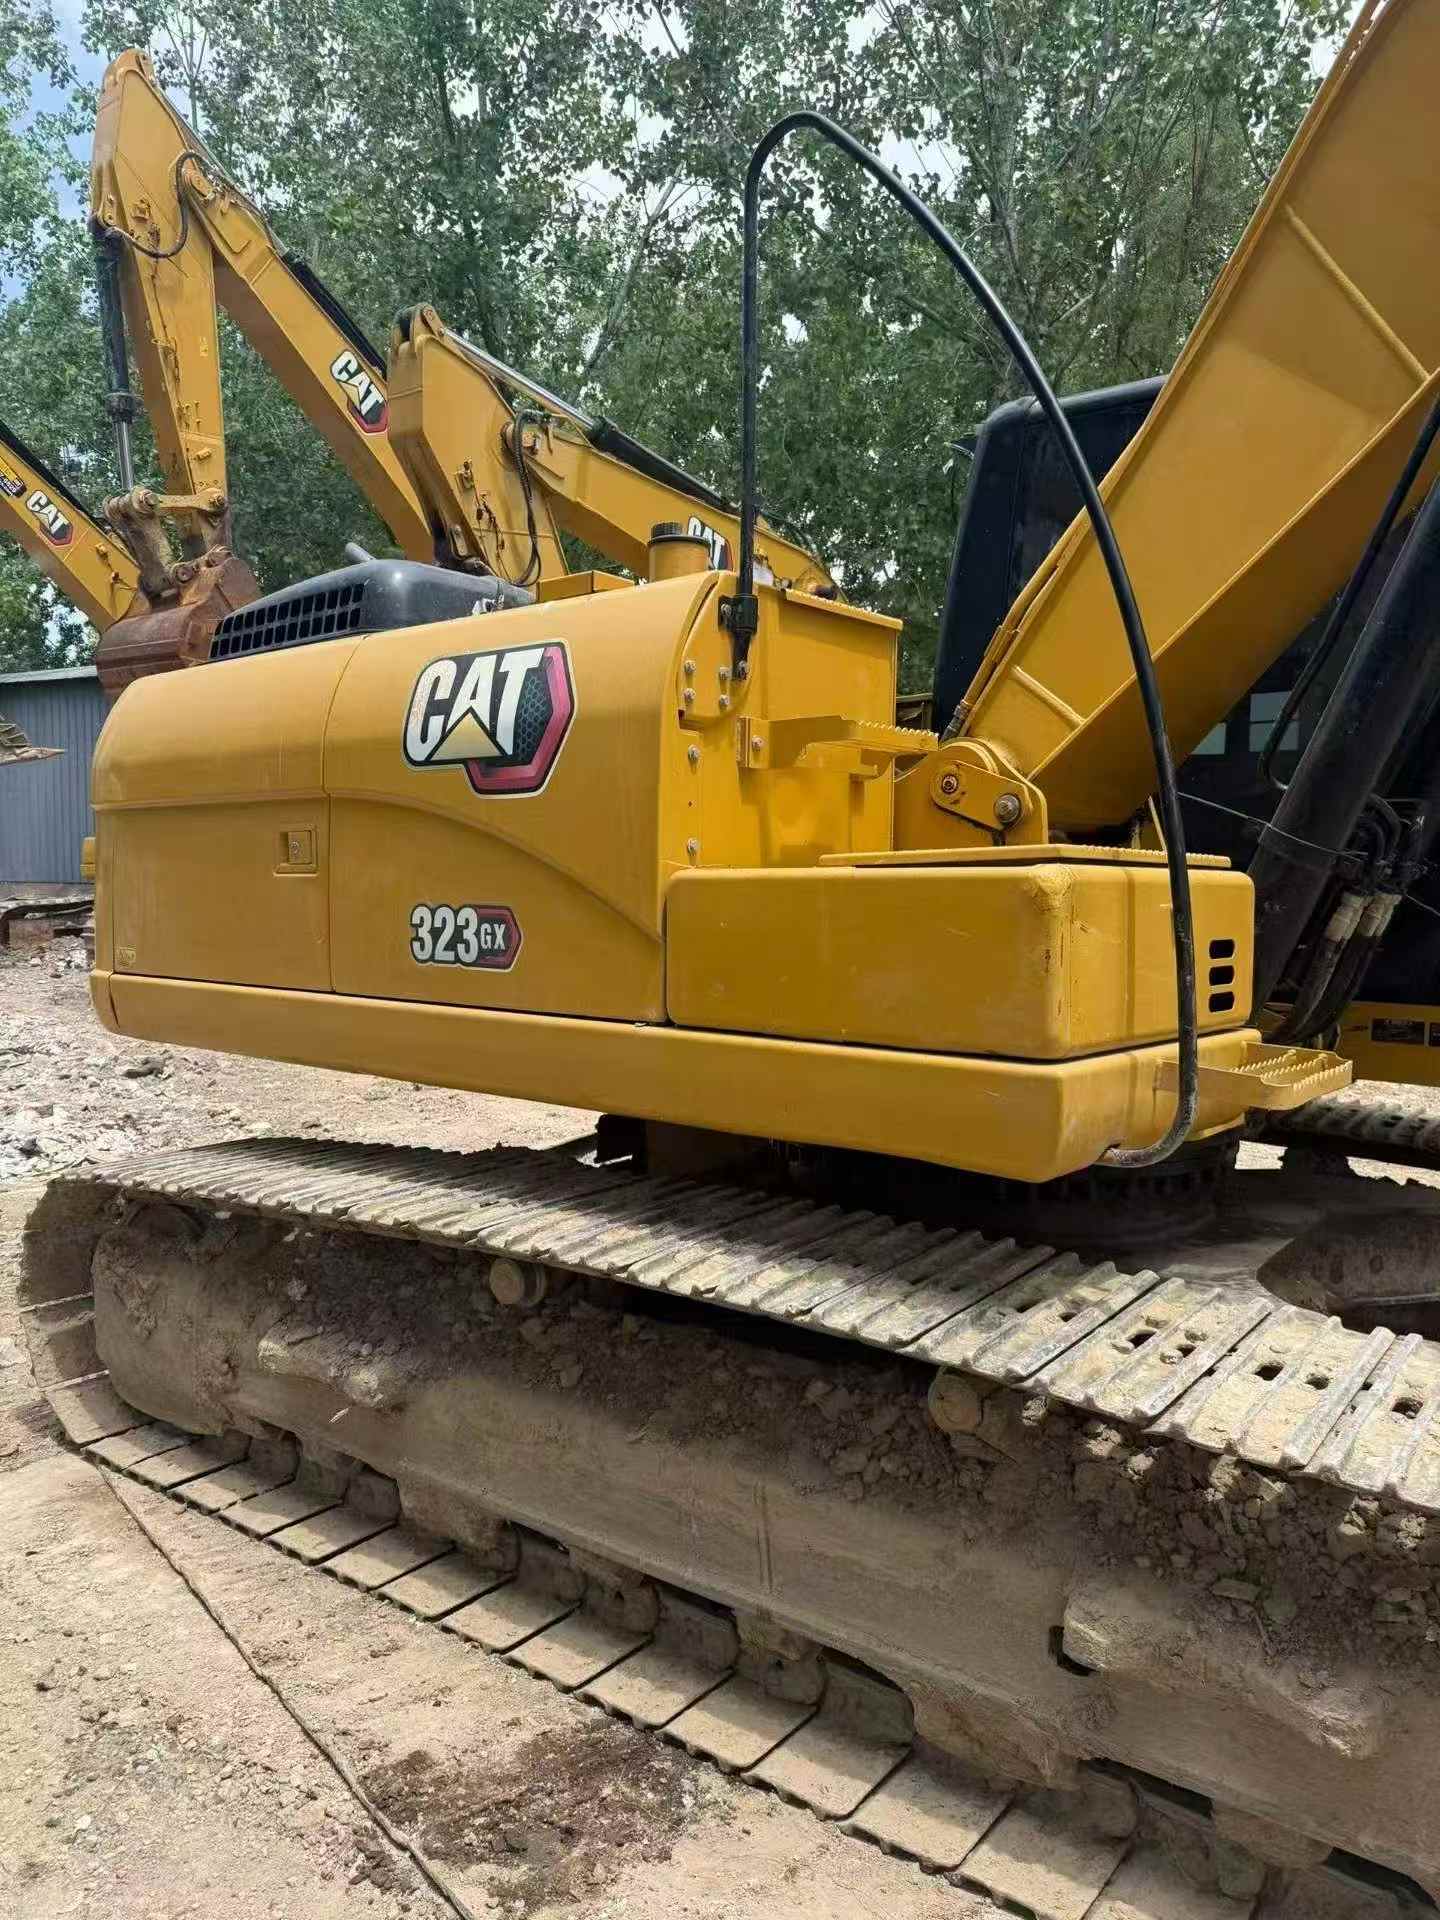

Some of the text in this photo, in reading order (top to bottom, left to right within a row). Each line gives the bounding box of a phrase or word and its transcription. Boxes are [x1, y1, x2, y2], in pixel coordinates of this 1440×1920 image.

[331, 351, 385, 416] CAT
[26, 490, 69, 534] CAT
[406, 647, 545, 761] CAT
